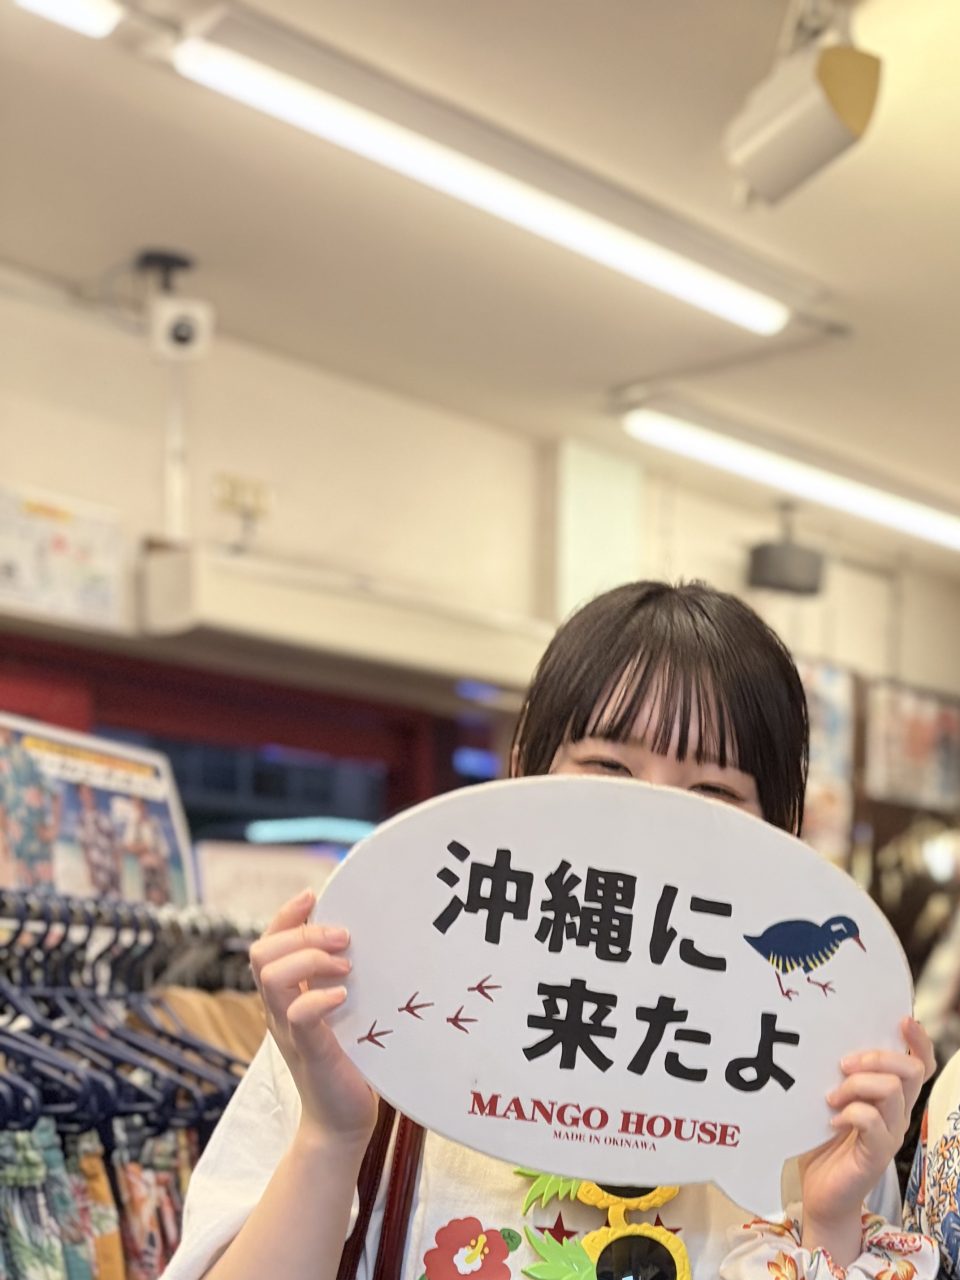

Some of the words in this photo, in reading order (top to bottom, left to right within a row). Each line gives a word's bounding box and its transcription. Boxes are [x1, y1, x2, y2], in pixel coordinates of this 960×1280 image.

[432, 839, 732, 972] 沖縄に
[522, 978, 800, 1092] 来たよ
[468, 1090, 609, 1130] MANGO
[617, 1110, 741, 1148] HOUSE
[553, 1130, 586, 1141] MADE
[588, 1135, 601, 1145] IN
[604, 1136, 657, 1151] OKINAWA
